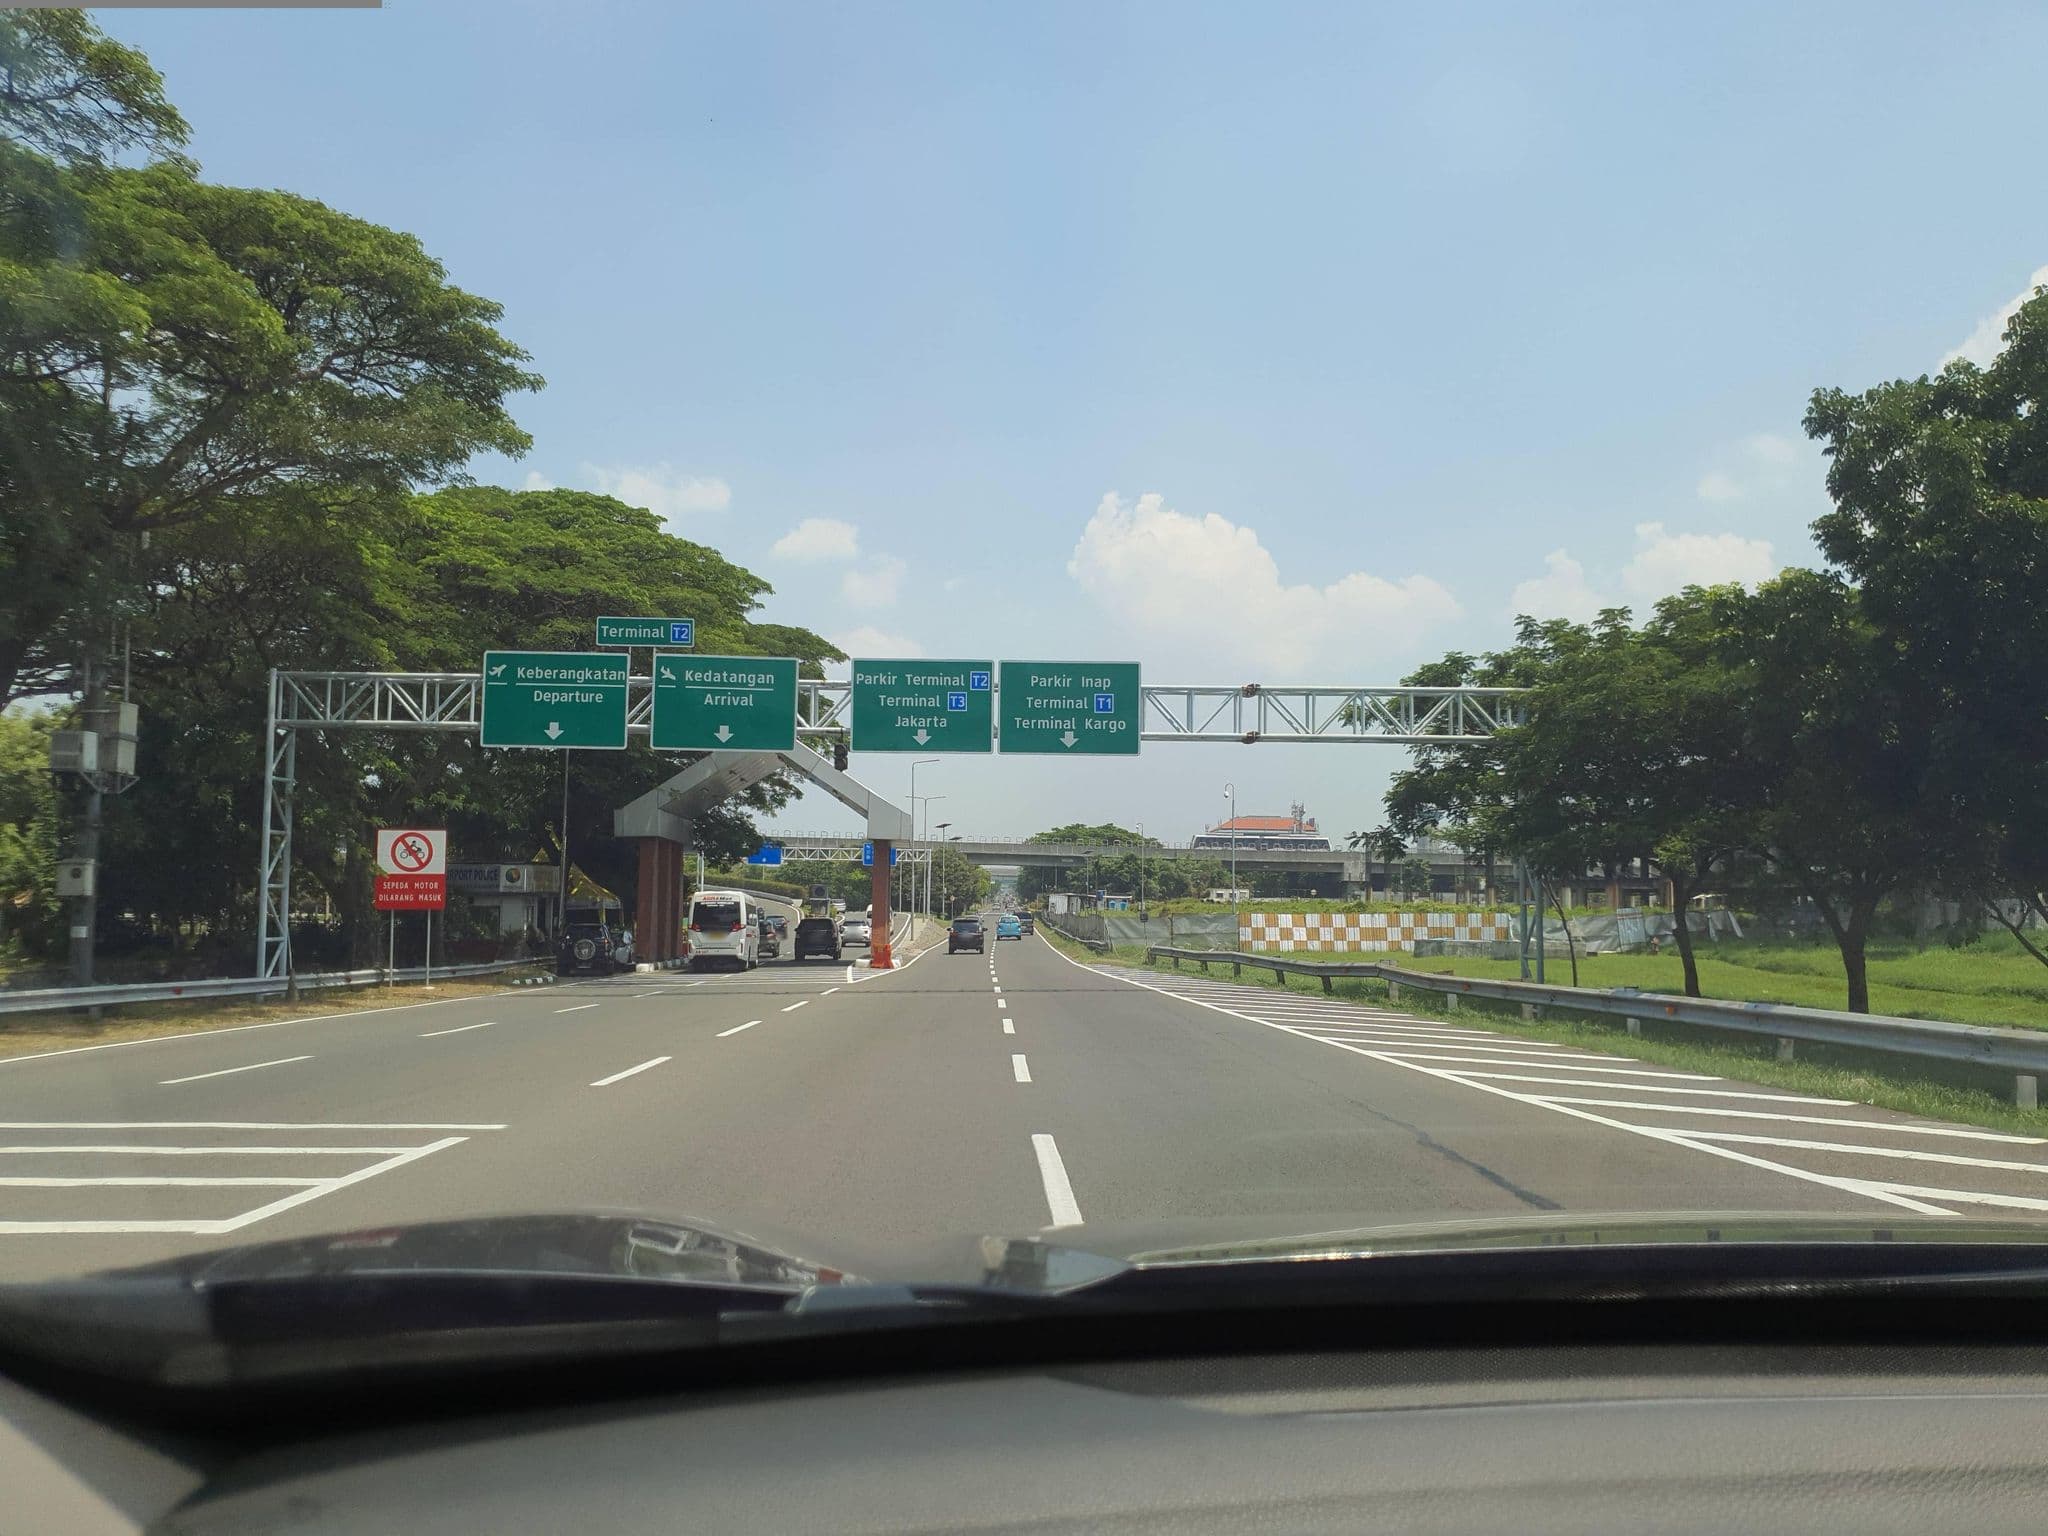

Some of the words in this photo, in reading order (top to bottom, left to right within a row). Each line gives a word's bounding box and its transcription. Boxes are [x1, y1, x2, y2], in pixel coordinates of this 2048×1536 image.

[601, 625, 665, 638] Terminal
[673, 627, 689, 639] T2
[517, 667, 626, 683] Keberangkatan
[685, 670, 775, 687] Kedatangan
[856, 672, 898, 685] Parkir
[905, 672, 965, 686] Terminal
[972, 675, 988, 687] T2
[1031, 674, 1072, 687] Parkir
[1081, 676, 1111, 690] Inap
[533, 690, 604, 705] Departure
[704, 692, 754, 706] Arrival
[879, 693, 941, 707] Terminal
[950, 695, 965, 708] T3
[1026, 695, 1089, 709] Terminal
[1097, 697, 1112, 710] T1
[895, 715, 947, 728] Jakarta
[1014, 716, 1076, 730] Terminal
[1085, 718, 1126, 733] Kargo
[383, 881, 409, 890] SEPEDA
[414, 881, 439, 890] MOTOR
[378, 894, 414, 902] DILARANG
[418, 894, 442, 902] MASUK
